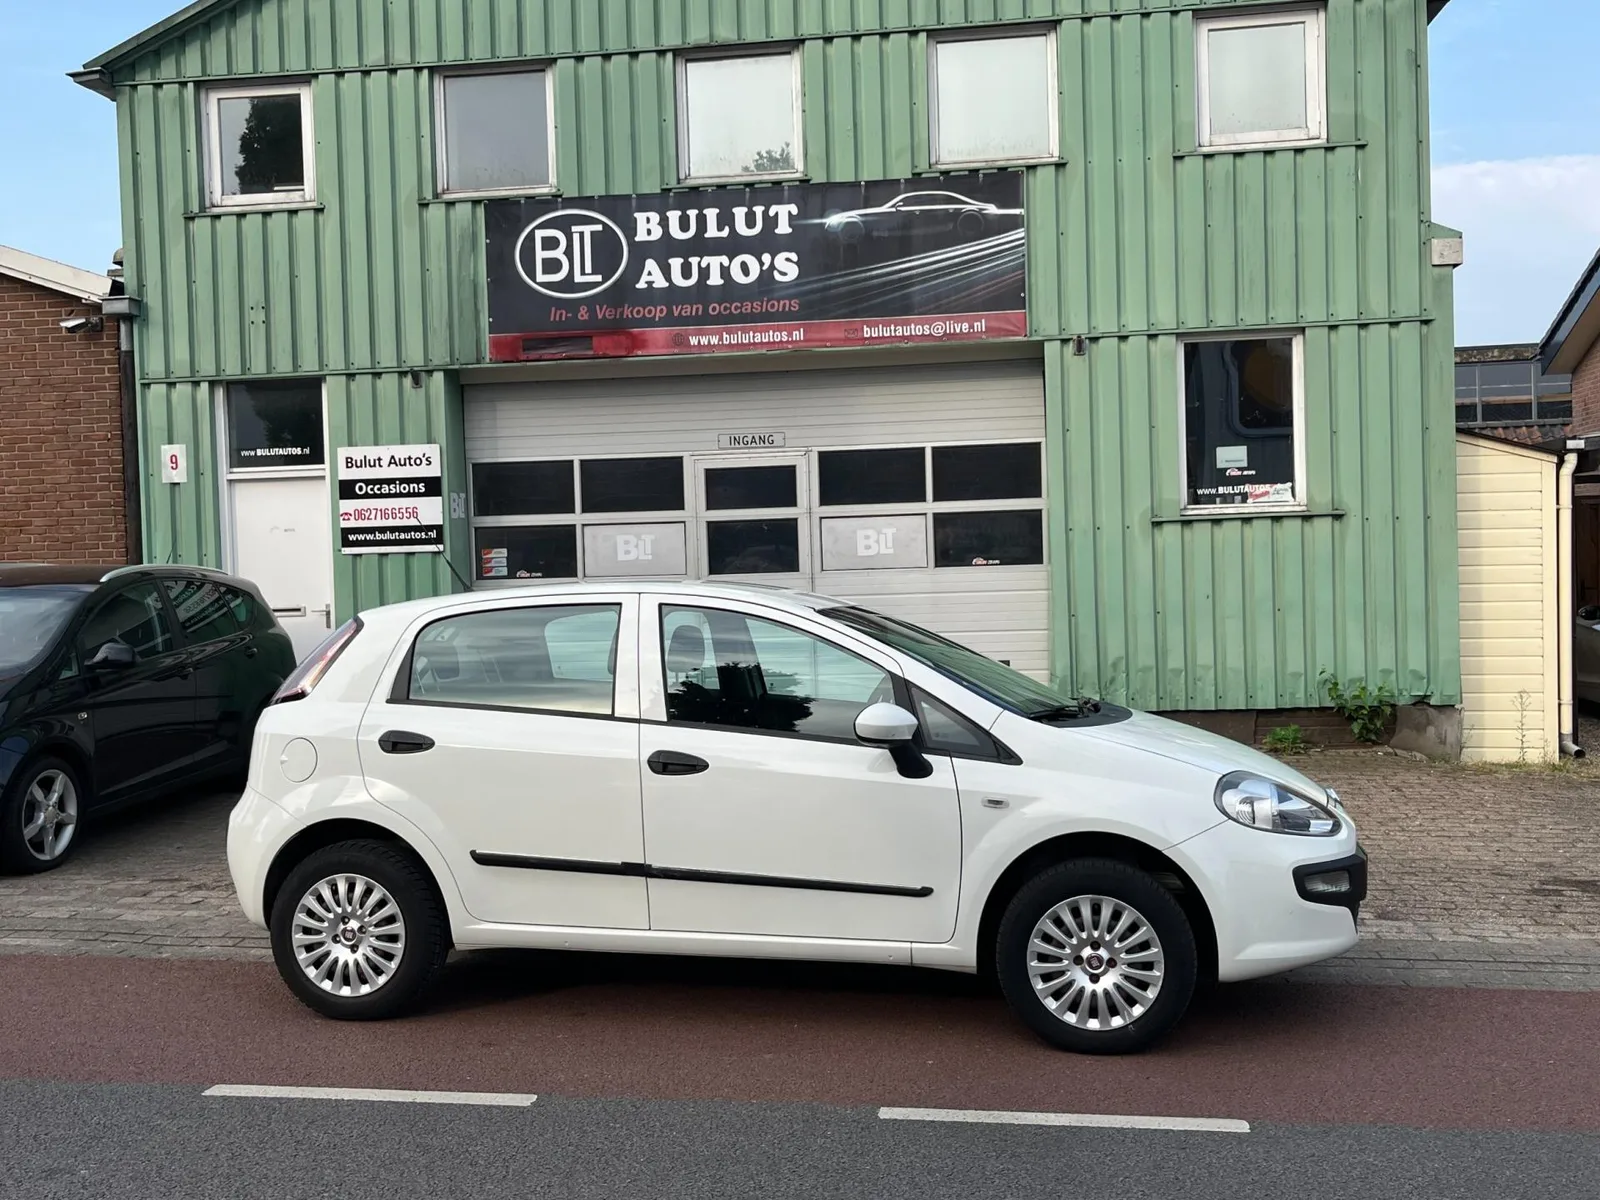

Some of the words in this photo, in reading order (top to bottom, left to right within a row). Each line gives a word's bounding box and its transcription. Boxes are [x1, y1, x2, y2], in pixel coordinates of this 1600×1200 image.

[633, 203, 799, 242] BULUT
[635, 251, 799, 289] AUTO'S
[550, 306, 572, 322] In-
[577, 305, 590, 321] &
[595, 303, 667, 321] Verkoop
[673, 303, 703, 318] van
[708, 297, 800, 316] occasions
[689, 328, 804, 346] www.bulutautos.nl
[863, 319, 986, 338] bulutautos@live.nl
[729, 434, 775, 447] INGANG
[169, 454, 179, 471] 9
[345, 455, 383, 469] Bulut
[387, 453, 432, 468] Auto's
[355, 481, 426, 495] Occasions
[353, 506, 419, 521] 0627166556
[348, 529, 437, 541] www.bulutautos.nl
